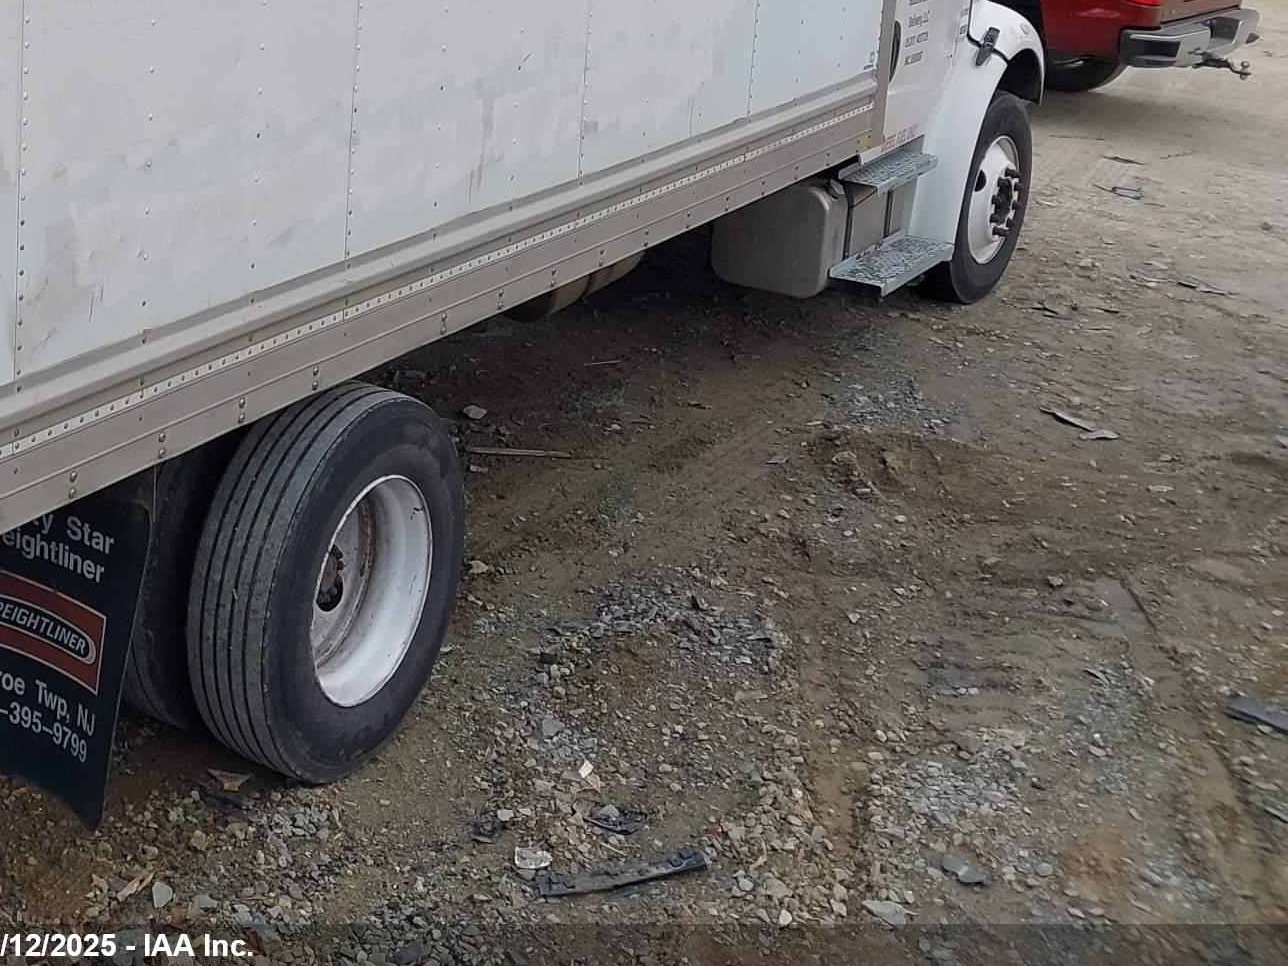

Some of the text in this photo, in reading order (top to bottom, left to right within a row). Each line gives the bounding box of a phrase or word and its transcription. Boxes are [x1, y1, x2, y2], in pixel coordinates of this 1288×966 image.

[66, 515, 115, 555] Star
[35, 678, 71, 726] Twp,
[76, 703, 97, 737] NJ
